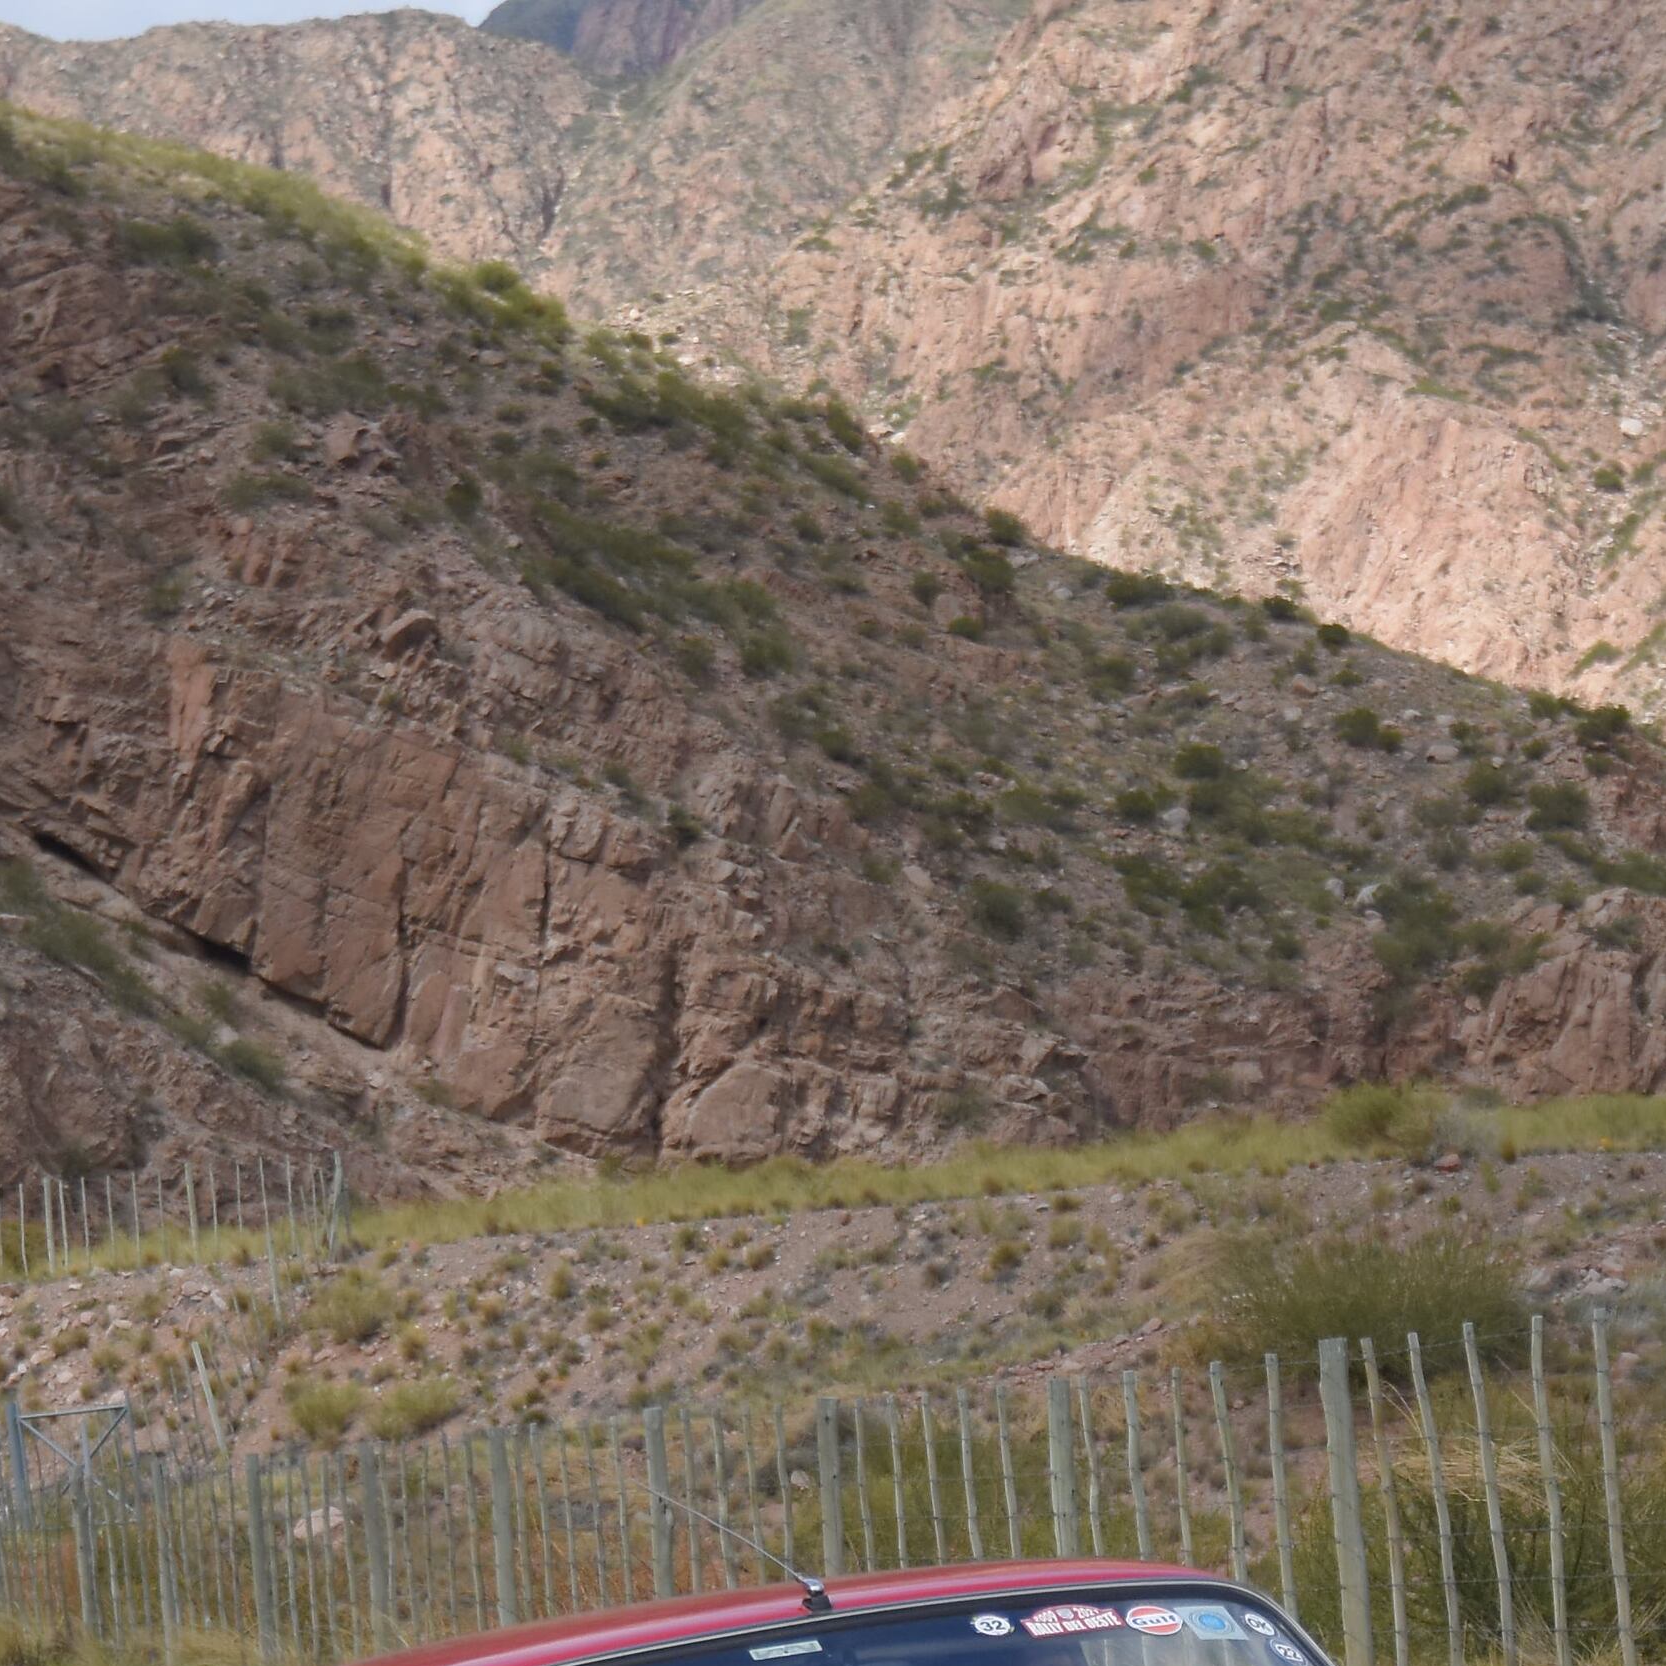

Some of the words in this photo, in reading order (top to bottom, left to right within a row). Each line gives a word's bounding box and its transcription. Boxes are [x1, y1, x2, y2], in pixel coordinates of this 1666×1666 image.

[979, 1620, 1007, 1632] 32
[1025, 1621, 1065, 1636] RALLY
[1061, 1620, 1088, 1632] DEL
[1083, 1611, 1122, 1629] OESTE
[1133, 1613, 1177, 1627] Gulf
